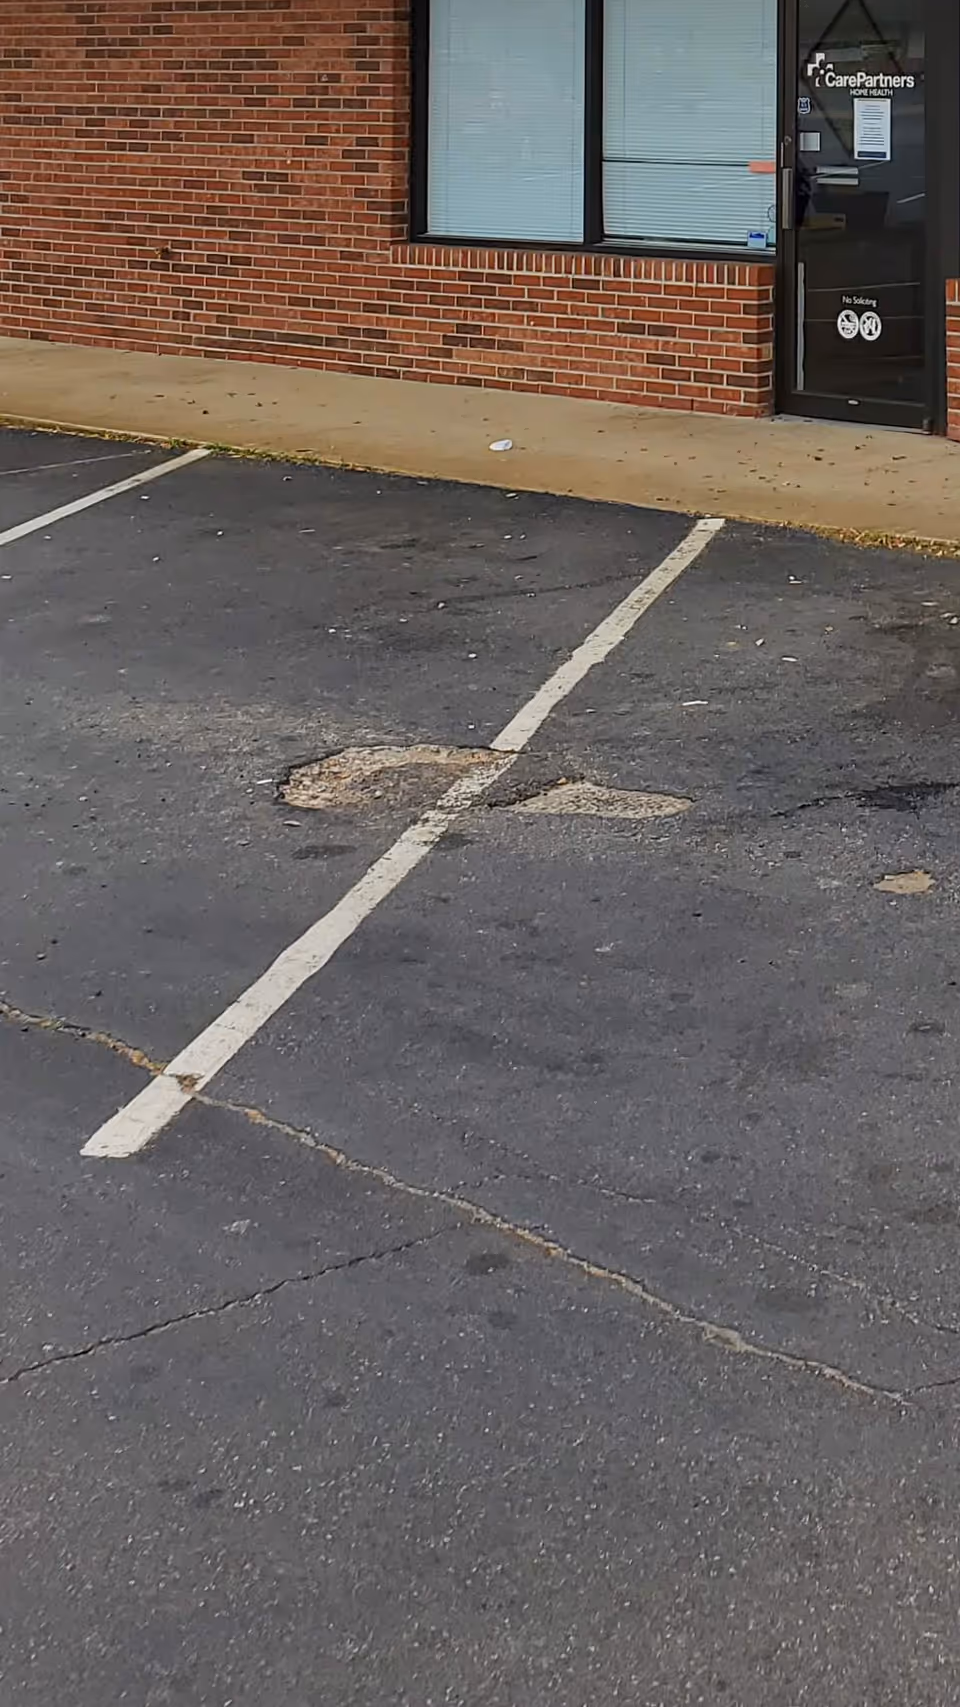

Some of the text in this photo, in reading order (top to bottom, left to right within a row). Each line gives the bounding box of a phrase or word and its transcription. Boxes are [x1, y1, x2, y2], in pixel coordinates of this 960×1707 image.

[825, 72, 915, 88] CarePartners
[850, 88, 893, 96] HOME HEALTH
[842, 295, 852, 304] No
